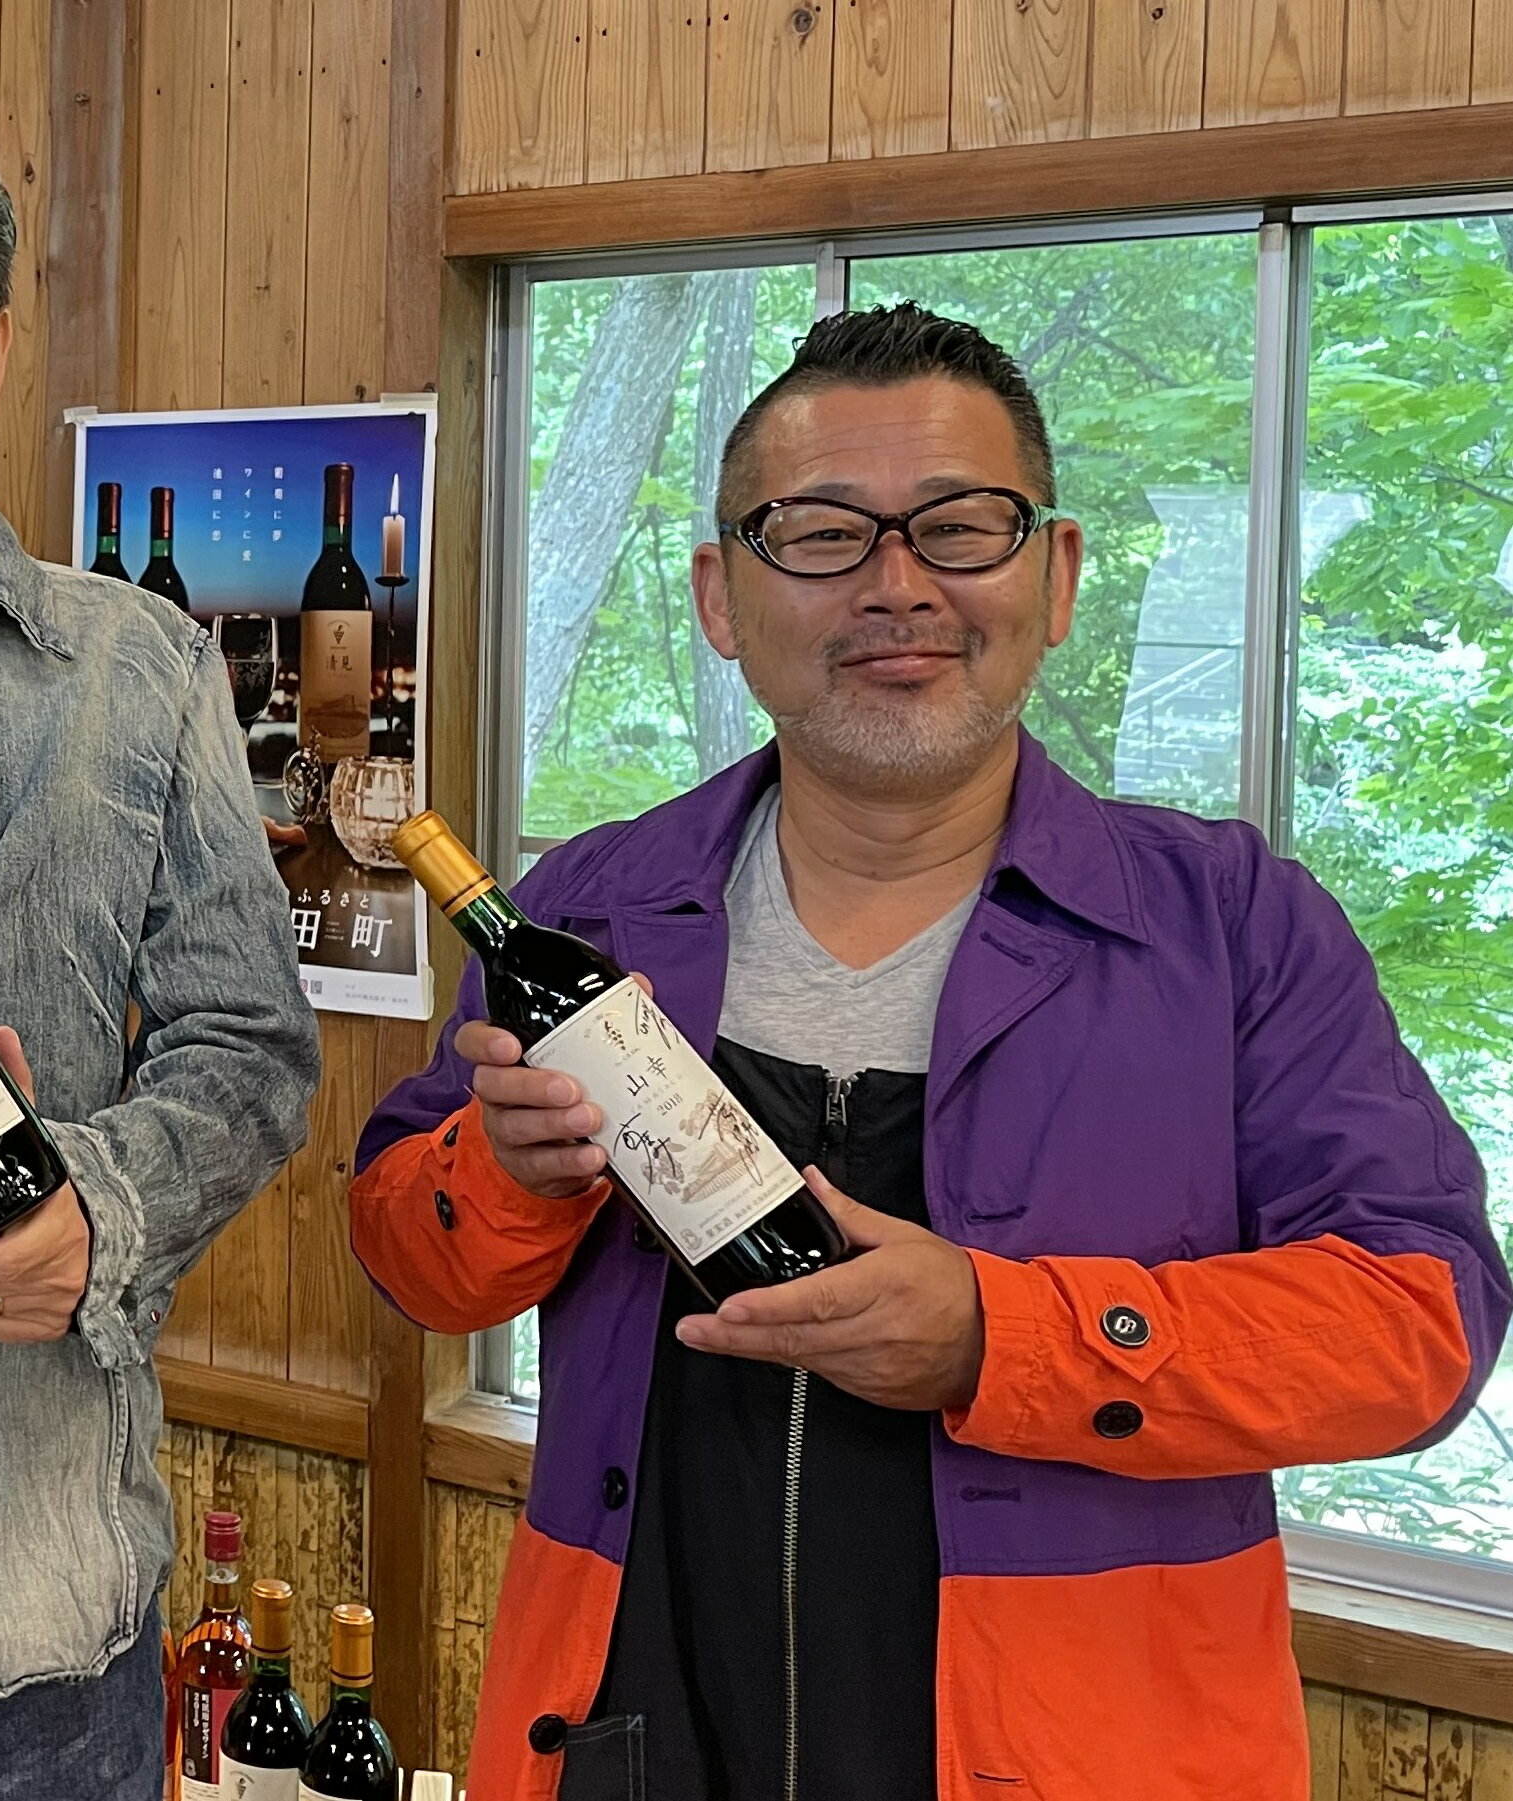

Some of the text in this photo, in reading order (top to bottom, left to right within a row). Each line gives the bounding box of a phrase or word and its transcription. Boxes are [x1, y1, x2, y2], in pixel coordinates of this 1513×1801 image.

[297, 887, 371, 909] ふるさと
[626, 1055, 668, 1097] 山幸
[656, 1092, 684, 1116] 2018
